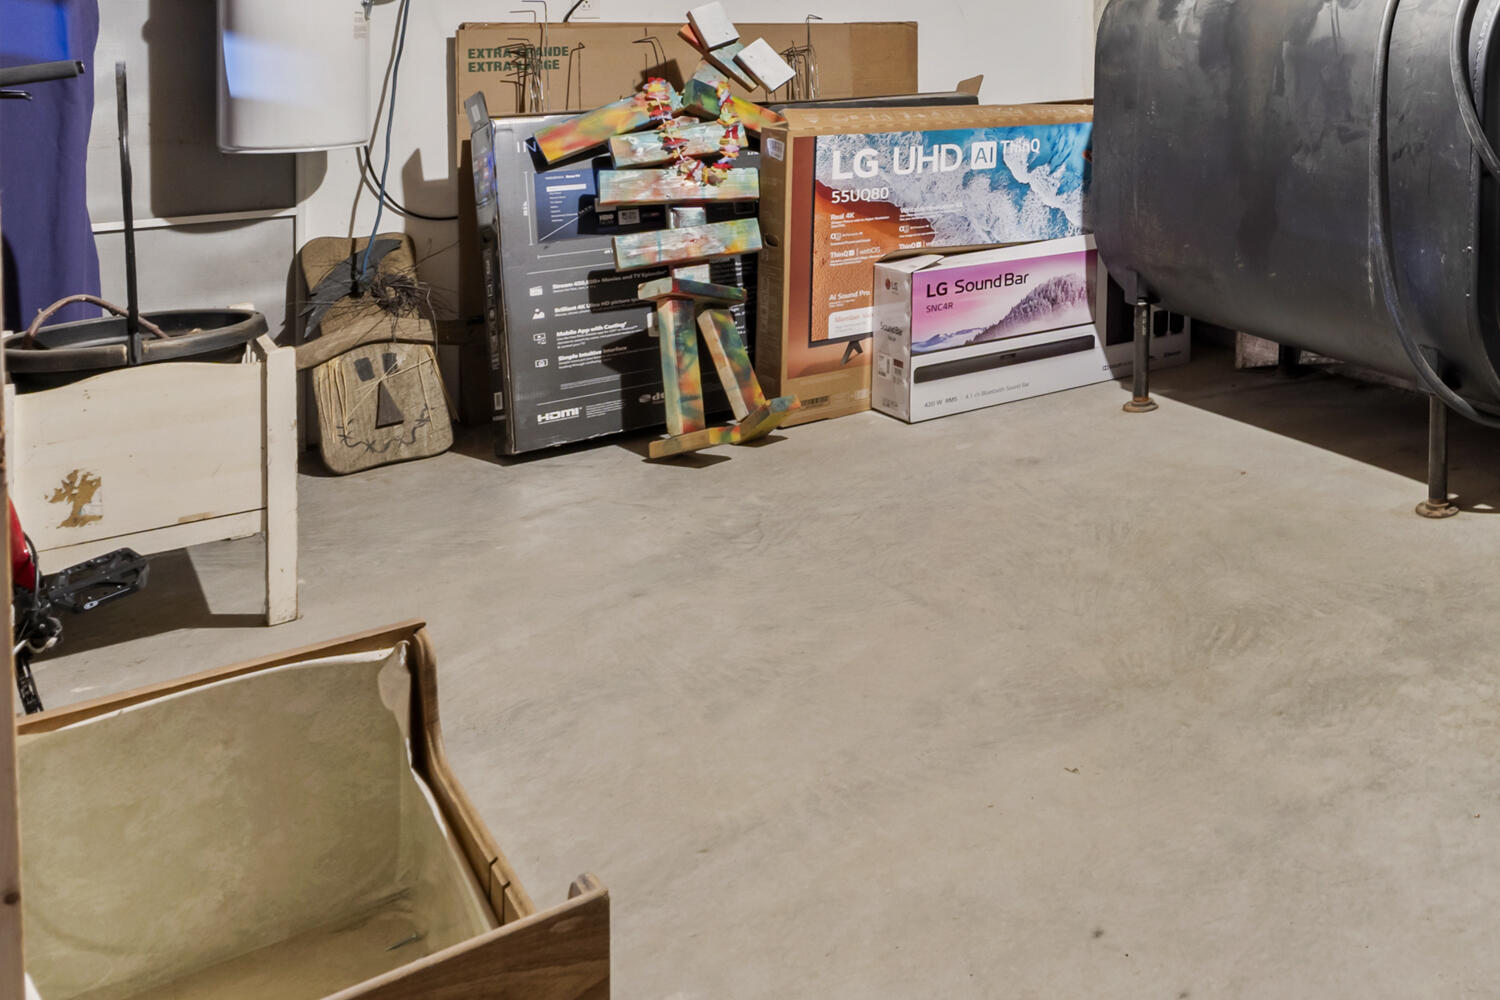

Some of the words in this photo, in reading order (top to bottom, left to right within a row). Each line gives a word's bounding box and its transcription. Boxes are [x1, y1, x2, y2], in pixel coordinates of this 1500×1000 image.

[468, 46, 569, 59] EXTRAGRANDE
[832, 148, 879, 180] LG
[893, 143, 963, 175] UHD
[974, 146, 994, 164] AI
[1000, 138, 1040, 154] ThinQ
[832, 187, 889, 204] 55UQ80
[926, 282, 948, 298] LG
[926, 302, 954, 313] SNC4R
[537, 406, 580, 423] HDMI
